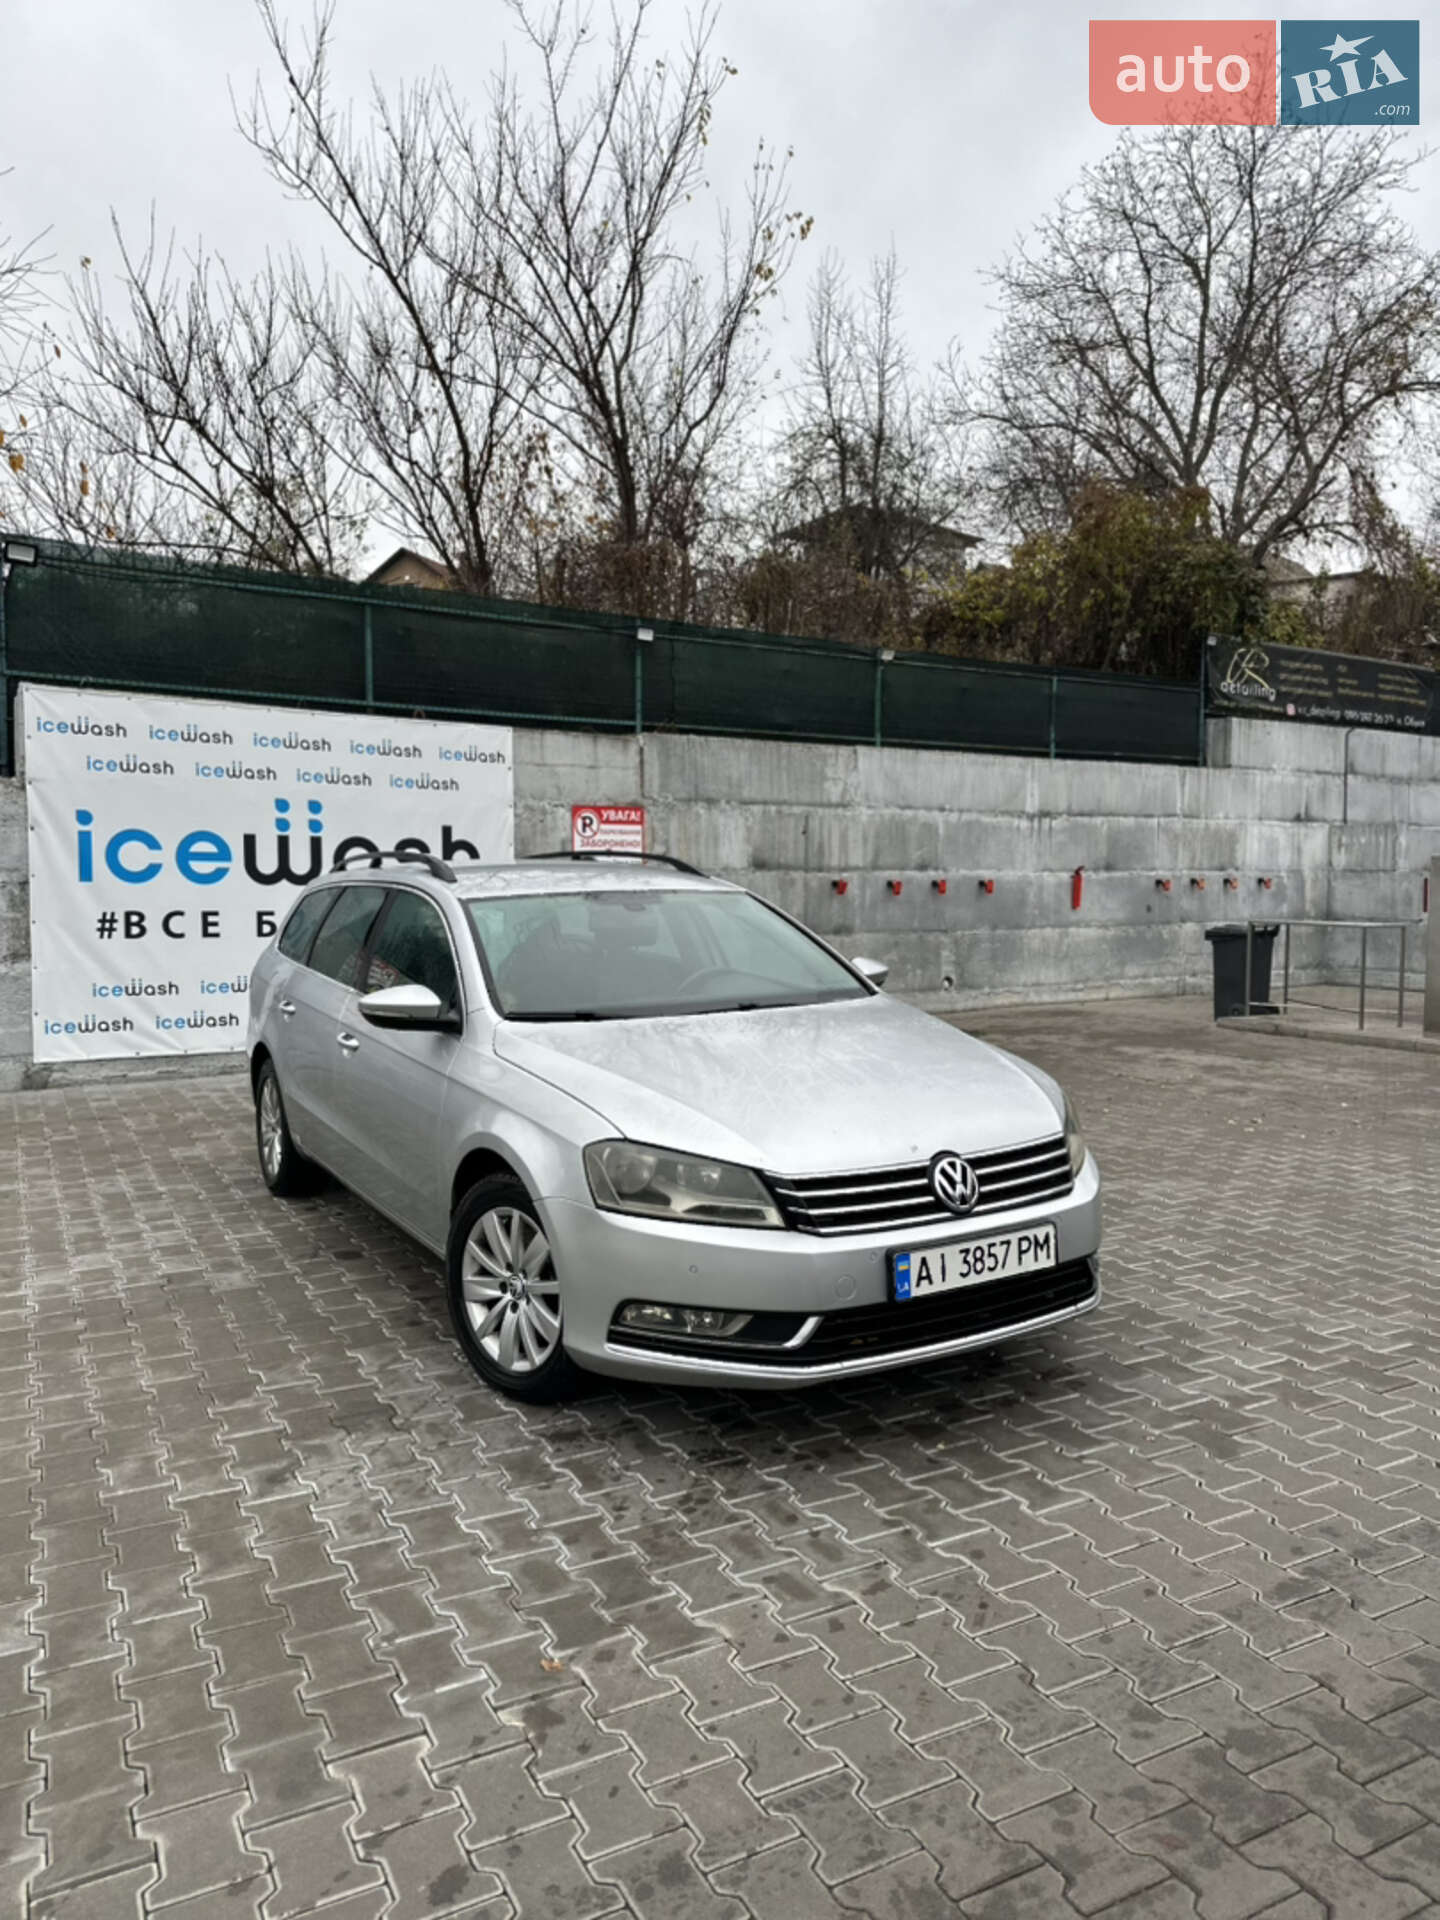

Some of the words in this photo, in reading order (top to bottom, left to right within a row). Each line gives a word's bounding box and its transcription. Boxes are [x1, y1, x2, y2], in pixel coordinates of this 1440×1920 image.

[36, 716, 128, 738] icewash
[149, 724, 234, 746] icewash
[253, 731, 332, 752] icewash
[350, 739, 423, 759] icewash
[438, 745, 506, 764] icewash
[86, 754, 175, 776] icewash
[195, 761, 278, 781] icewash
[296, 767, 373, 787] icewash
[389, 773, 460, 792] icewash
[96, 910, 221, 940] #ВСЕ
[92, 978, 180, 998] icewash
[200, 975, 248, 995] icew
[44, 1014, 134, 1035] icewash
[155, 1010, 240, 1030] icewash
[916, 1252, 947, 1288] AI
[959, 1239, 1012, 1279] 3857
[1018, 1231, 1051, 1267] PM
